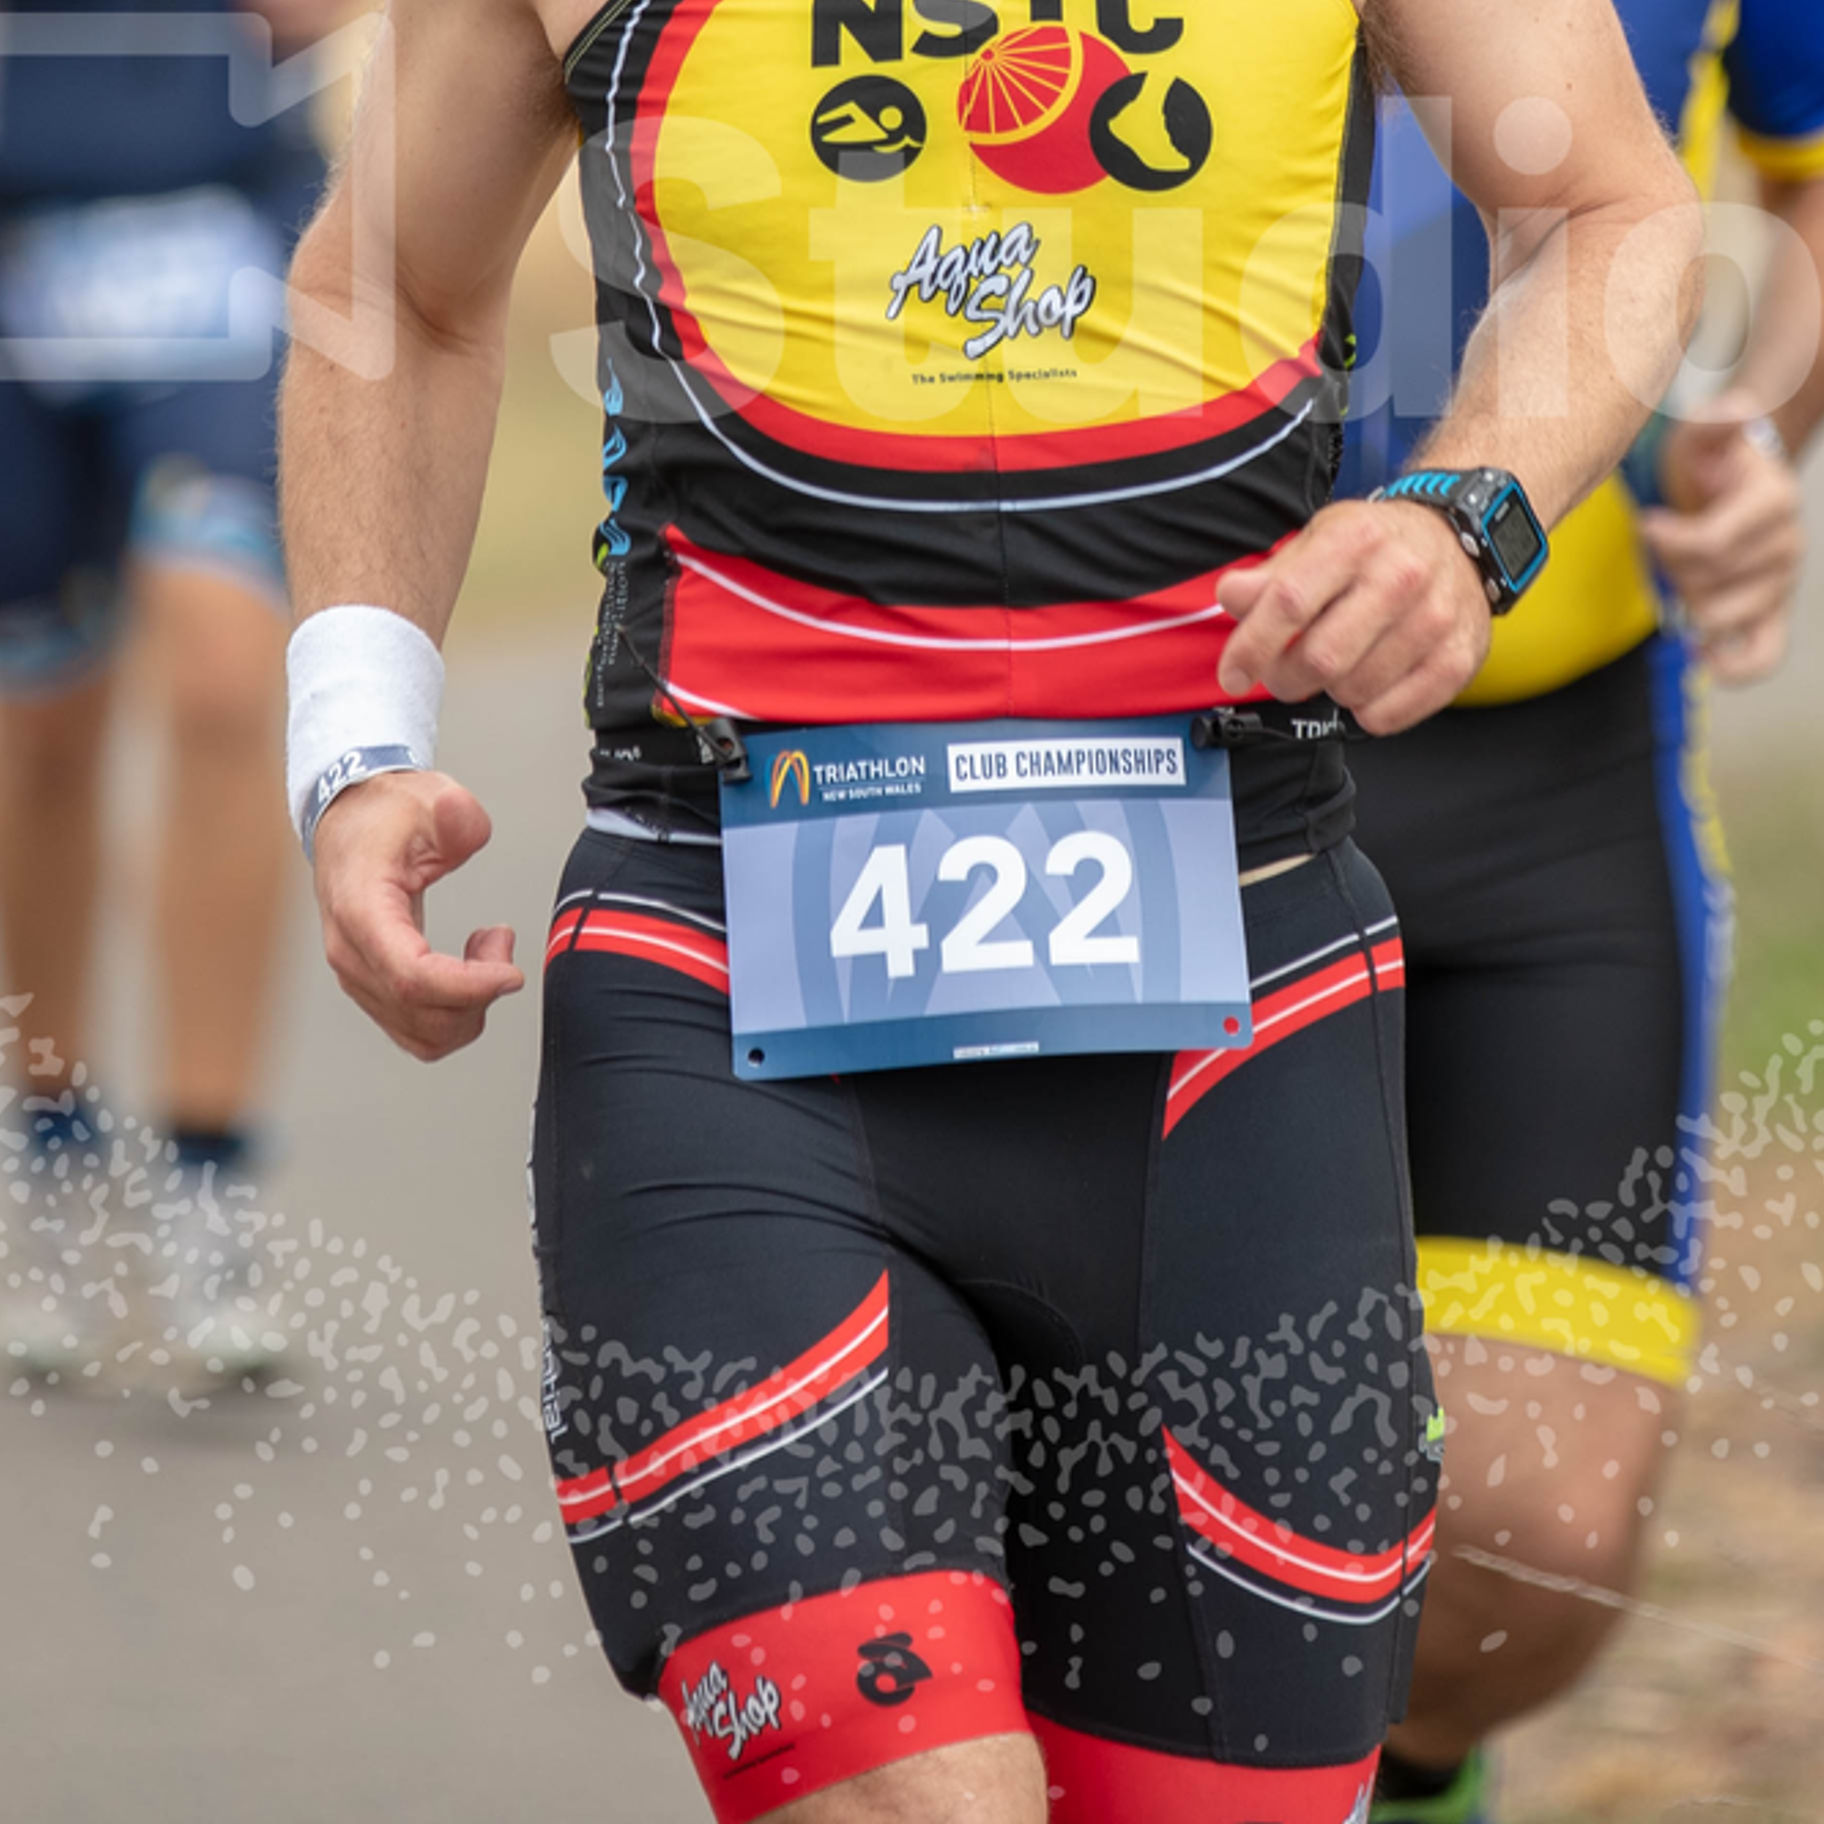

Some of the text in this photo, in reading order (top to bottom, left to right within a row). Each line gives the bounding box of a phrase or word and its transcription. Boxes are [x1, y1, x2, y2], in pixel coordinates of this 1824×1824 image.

[885, 219, 1041, 321] Aqua
[963, 263, 1097, 361] Shop
[912, 373, 935, 384] The
[317, 751, 366, 805] 422
[813, 755, 926, 785] TRIATHLON
[954, 747, 1177, 782] CLUB CHAMPIONSHIPS
[822, 782, 922, 802] NEW SOUTH WALES
[829, 830, 1141, 979] 422
[713, 1674, 782, 1761] Shop
